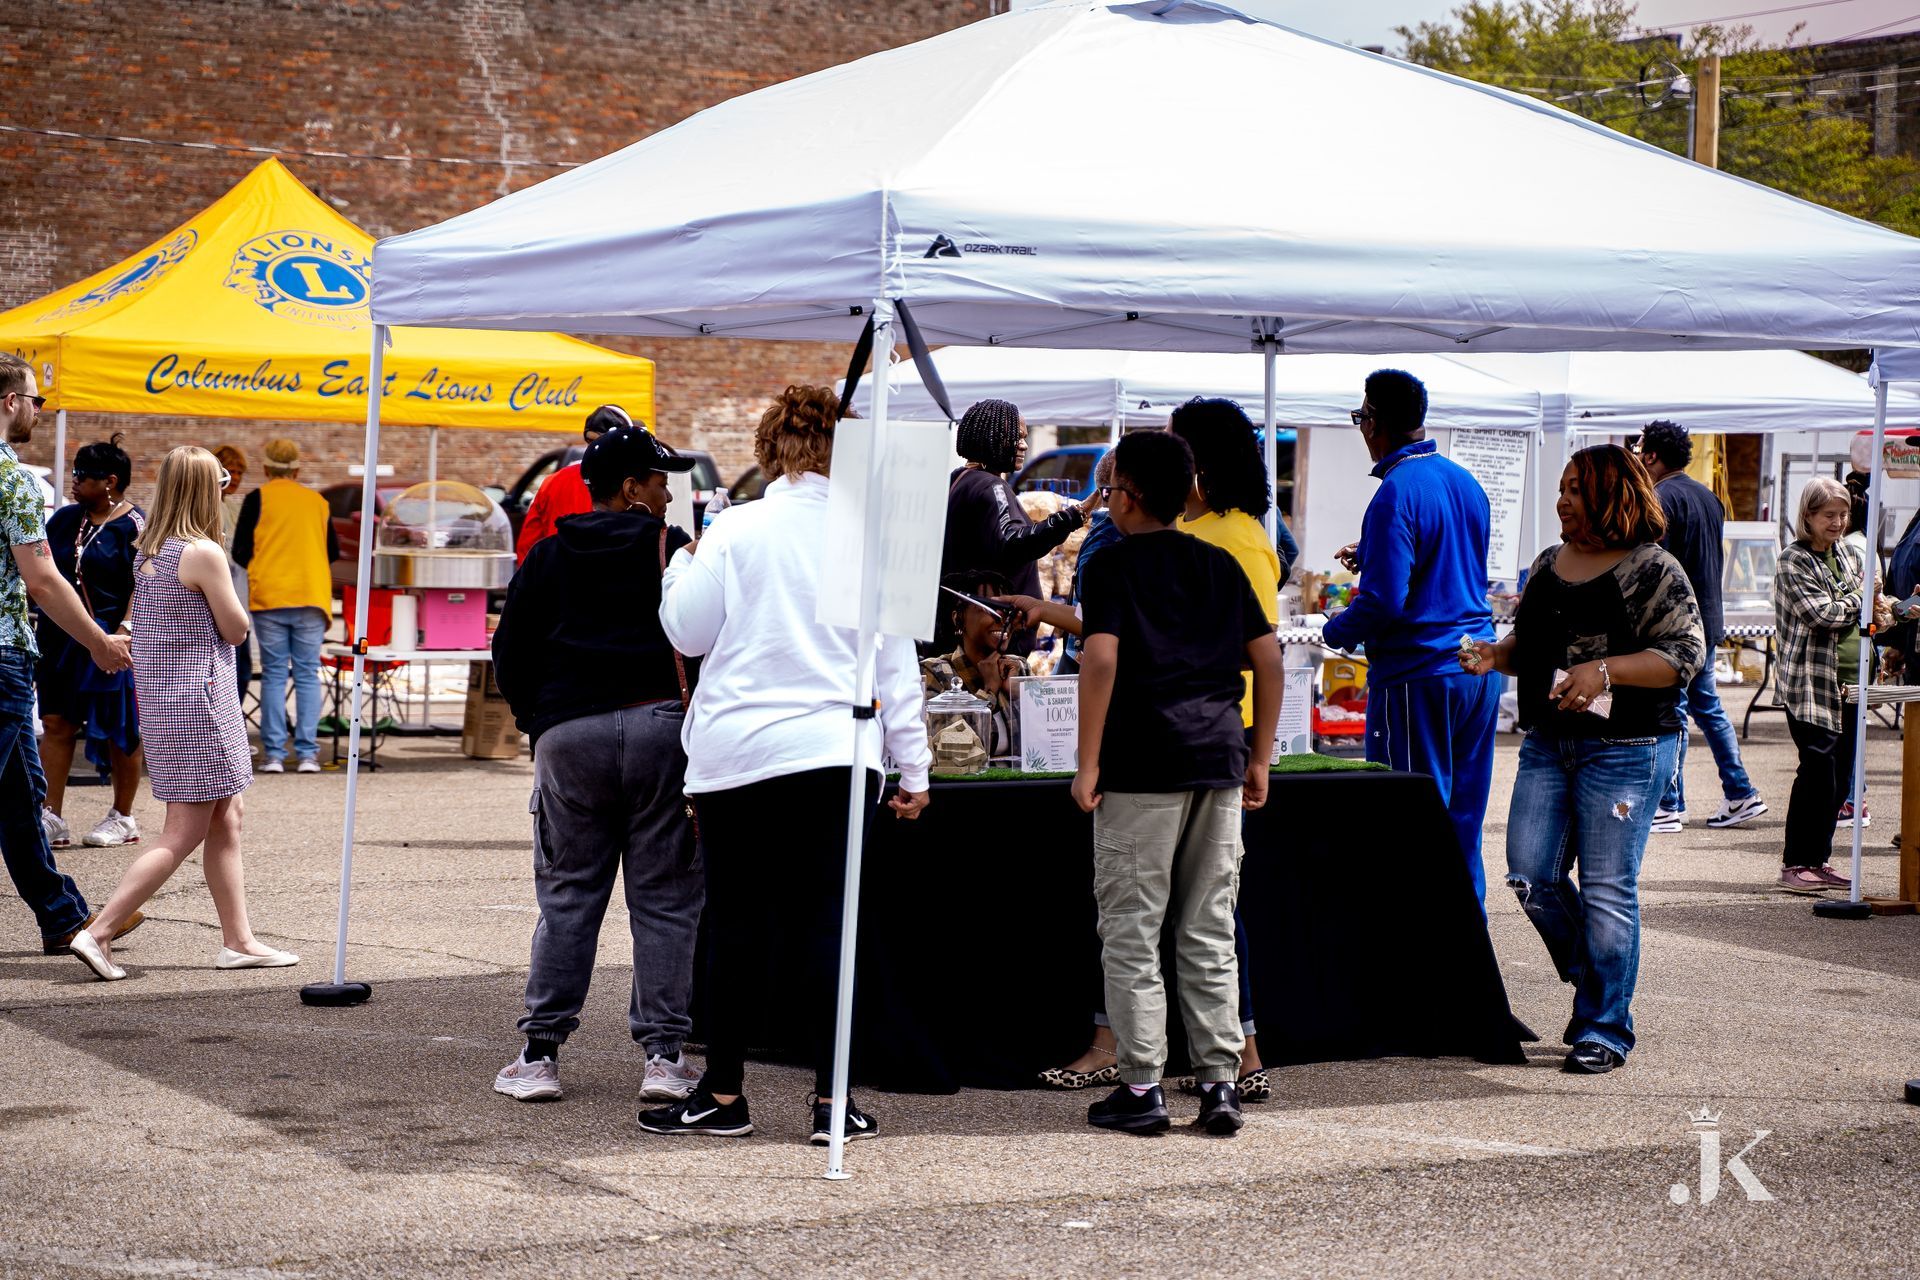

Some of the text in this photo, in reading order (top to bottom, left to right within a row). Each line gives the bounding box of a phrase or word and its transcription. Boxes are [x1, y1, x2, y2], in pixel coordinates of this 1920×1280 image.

[250, 235, 354, 261] LIONS
[291, 262, 355, 300] L
[144, 353, 582, 411] Columbus Eat Lions Club
[1499, 429, 1528, 439] CHURCH
[1057, 687, 1068, 695] HAIR
[1052, 697, 1073, 706] SHAMPOO
[1046, 706, 1077, 722] 100%
